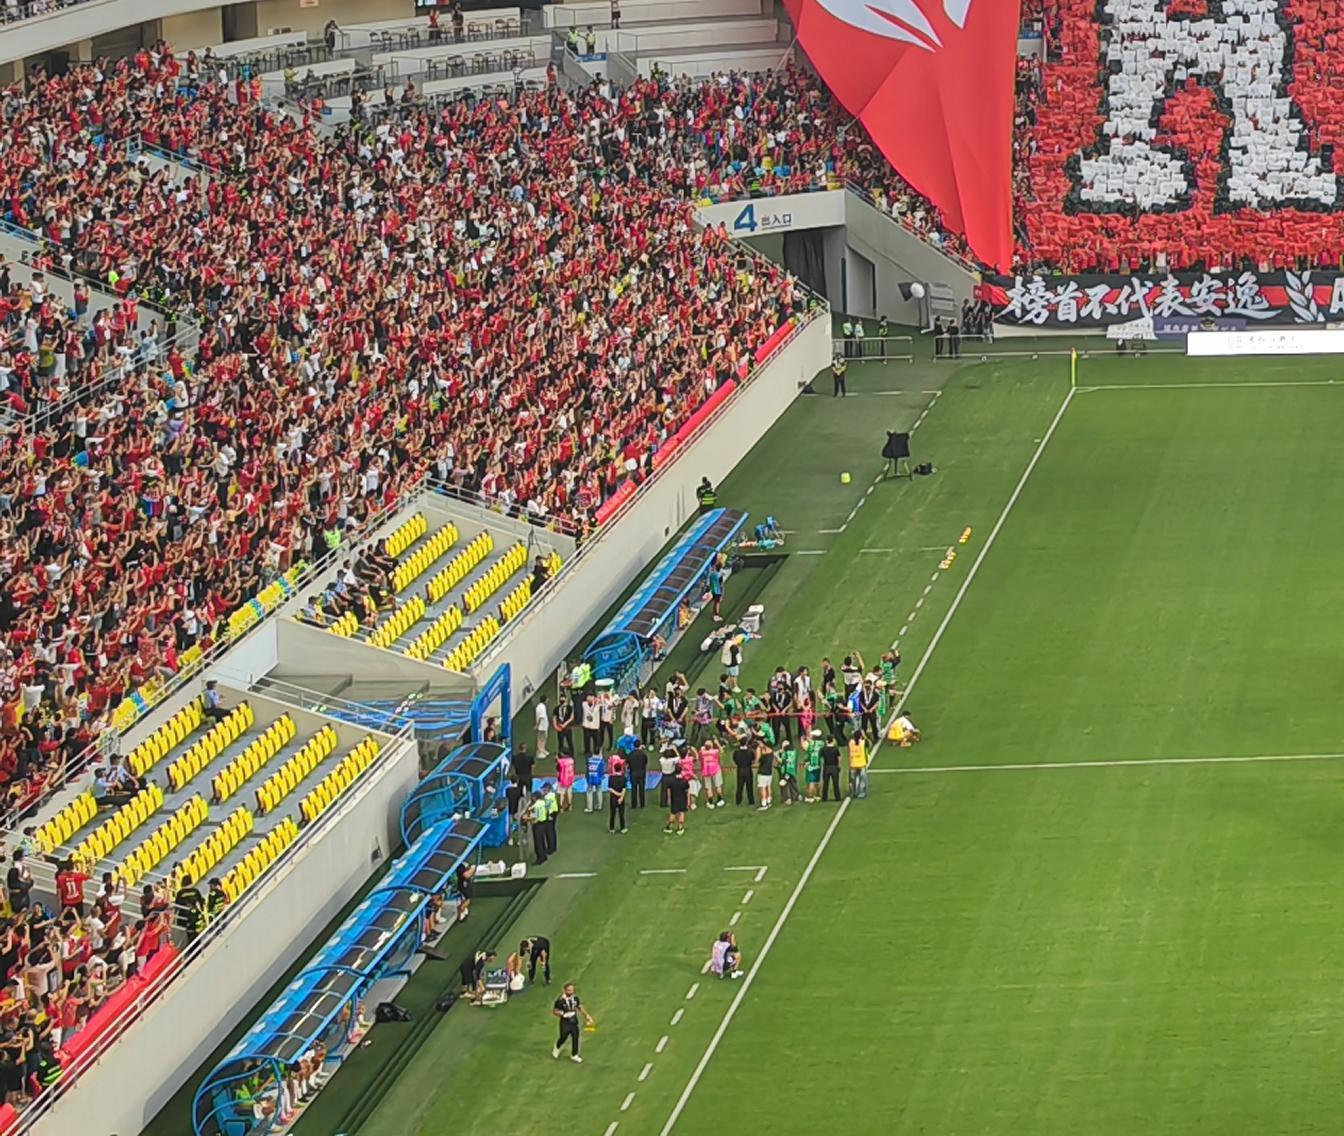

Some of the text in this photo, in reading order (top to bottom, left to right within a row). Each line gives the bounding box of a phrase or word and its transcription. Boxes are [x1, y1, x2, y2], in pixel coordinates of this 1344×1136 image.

[733, 203, 758, 232] 4
[761, 213, 792, 227] 出入口
[1000, 273, 1283, 324] 榜首不代表安逸
